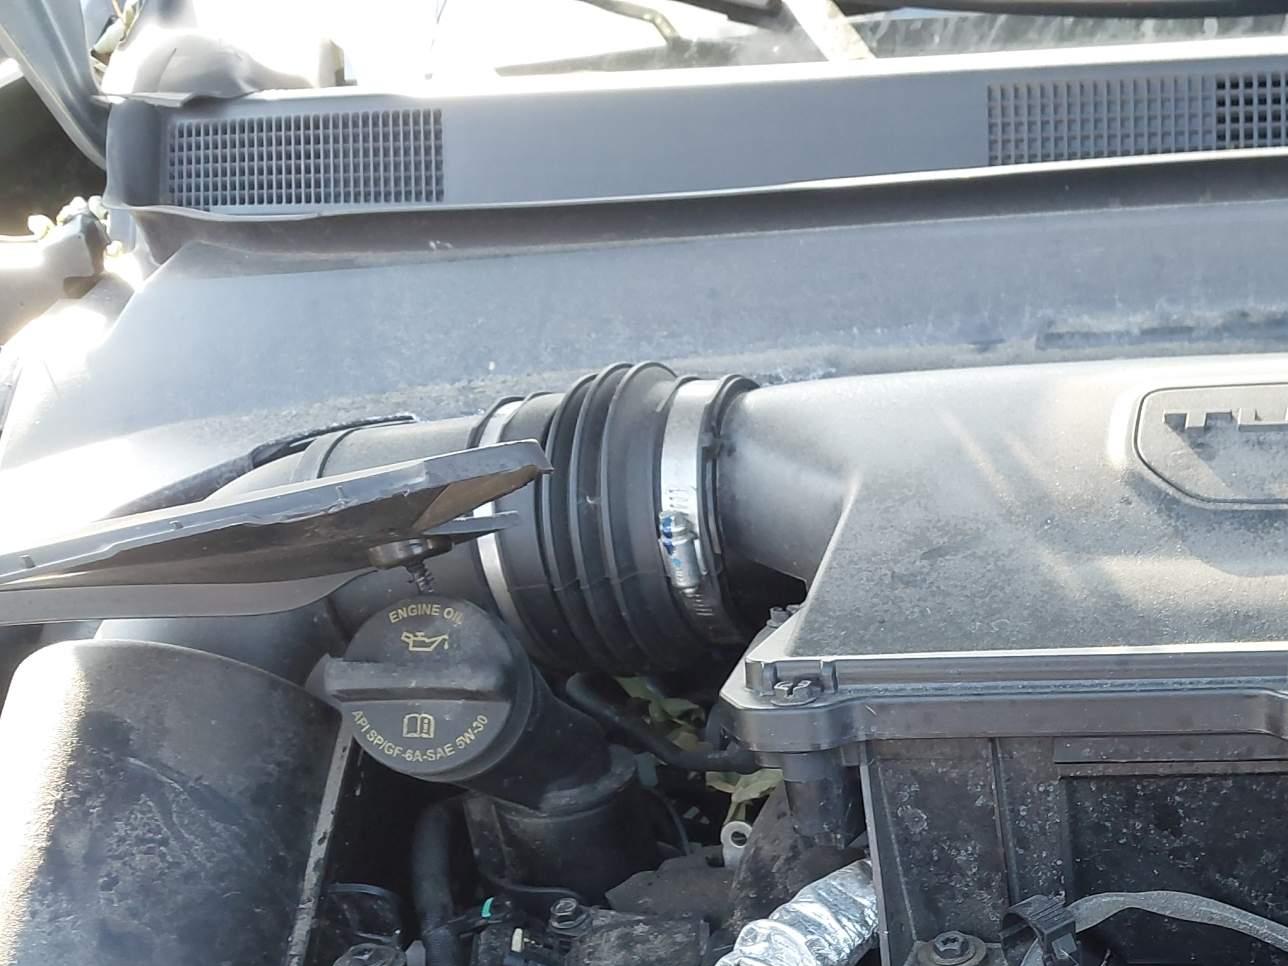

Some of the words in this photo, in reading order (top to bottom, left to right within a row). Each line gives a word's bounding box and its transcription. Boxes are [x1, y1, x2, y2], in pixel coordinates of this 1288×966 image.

[388, 604, 441, 624] ENGINE
[443, 607, 464, 626] OIL
[352, 710, 370, 733] API
[455, 714, 489, 750] 5W-30
